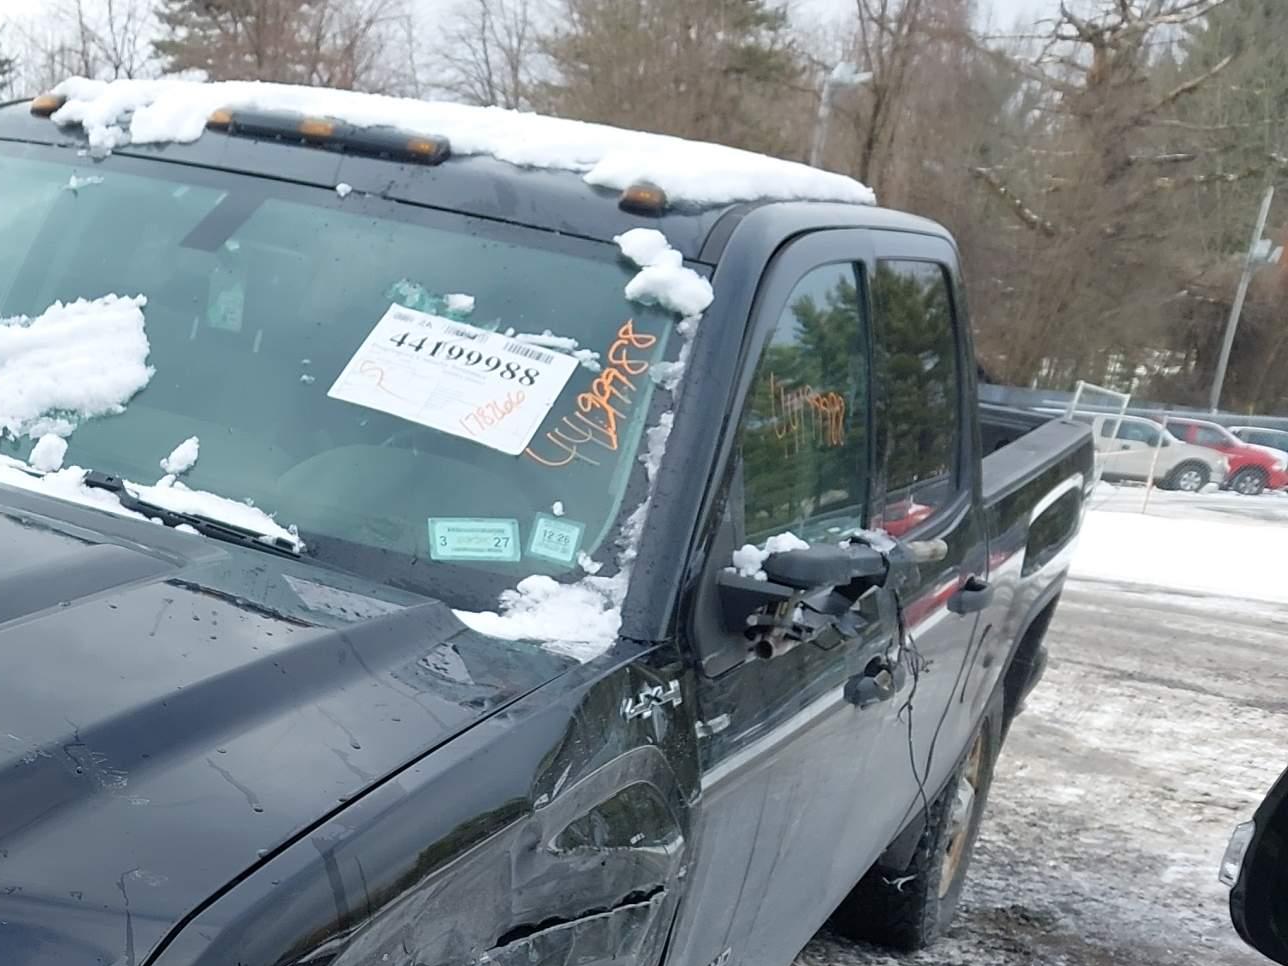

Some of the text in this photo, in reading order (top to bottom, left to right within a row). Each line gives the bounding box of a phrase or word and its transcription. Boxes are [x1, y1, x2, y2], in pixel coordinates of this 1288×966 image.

[389, 331, 541, 387] 44199988
[439, 535, 511, 549] 3 27
